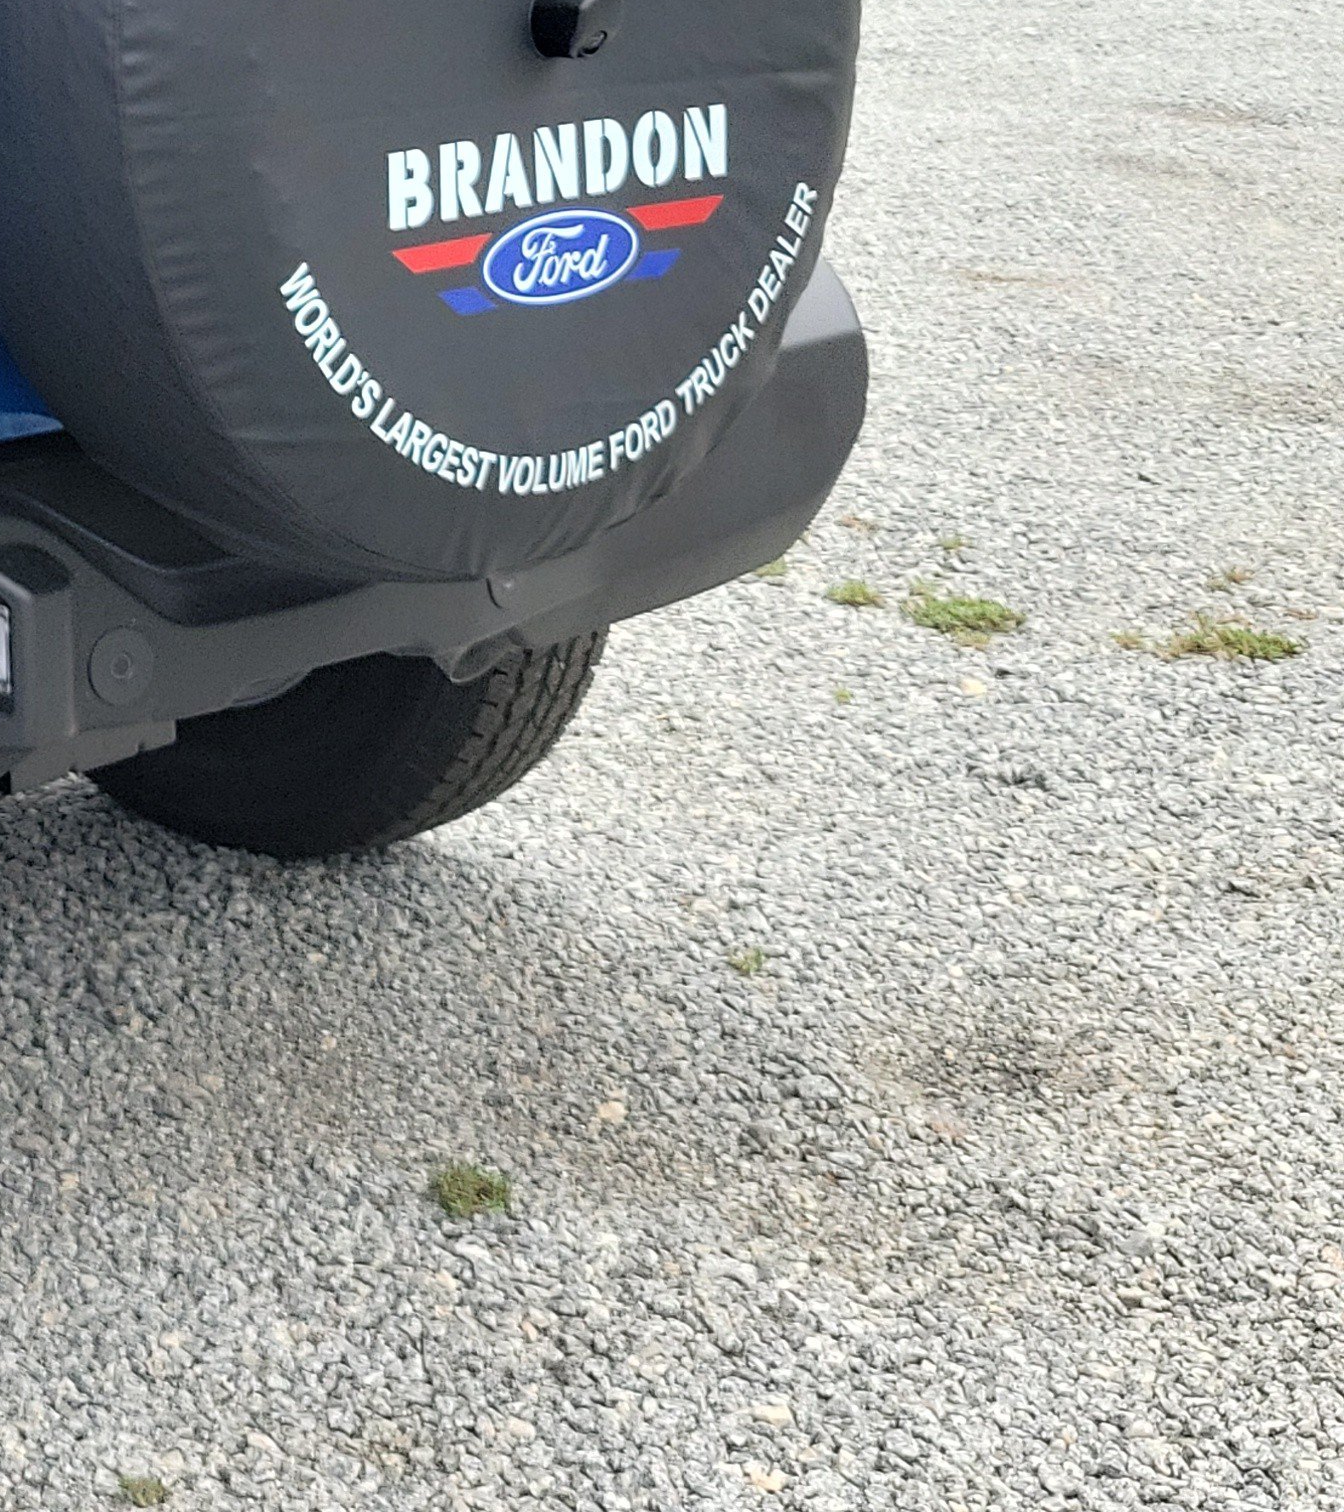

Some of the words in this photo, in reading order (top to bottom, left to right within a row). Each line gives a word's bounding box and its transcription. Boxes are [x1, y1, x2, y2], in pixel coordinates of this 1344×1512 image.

[387, 103, 728, 232] BRANDON
[513, 223, 609, 293] Ford
[279, 261, 383, 420] WORLD'S
[369, 396, 498, 491] LARGEST
[497, 439, 605, 496] VOLUME
[608, 398, 677, 471] FORD
[674, 311, 756, 415] TRUCK
[747, 181, 818, 325] DEALER
